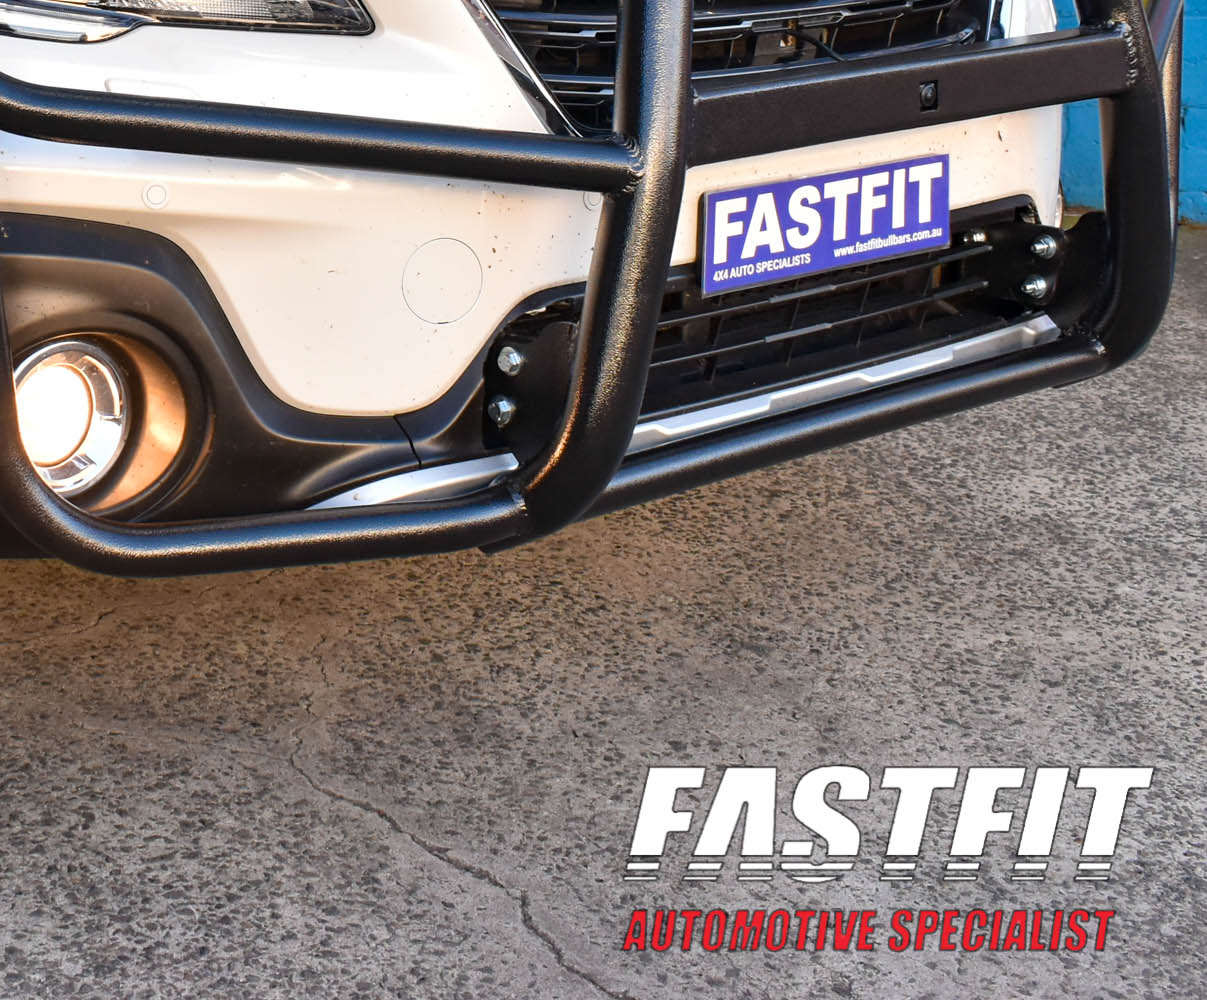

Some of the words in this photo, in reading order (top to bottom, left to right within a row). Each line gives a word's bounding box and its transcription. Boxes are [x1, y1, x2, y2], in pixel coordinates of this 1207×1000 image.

[713, 162, 942, 265] FASTFIT
[833, 227, 942, 258] www.fastfitbullbars.com.au
[713, 268, 729, 282] 4X4
[730, 261, 755, 279] AUTO
[755, 253, 812, 274] SPECIALISTS
